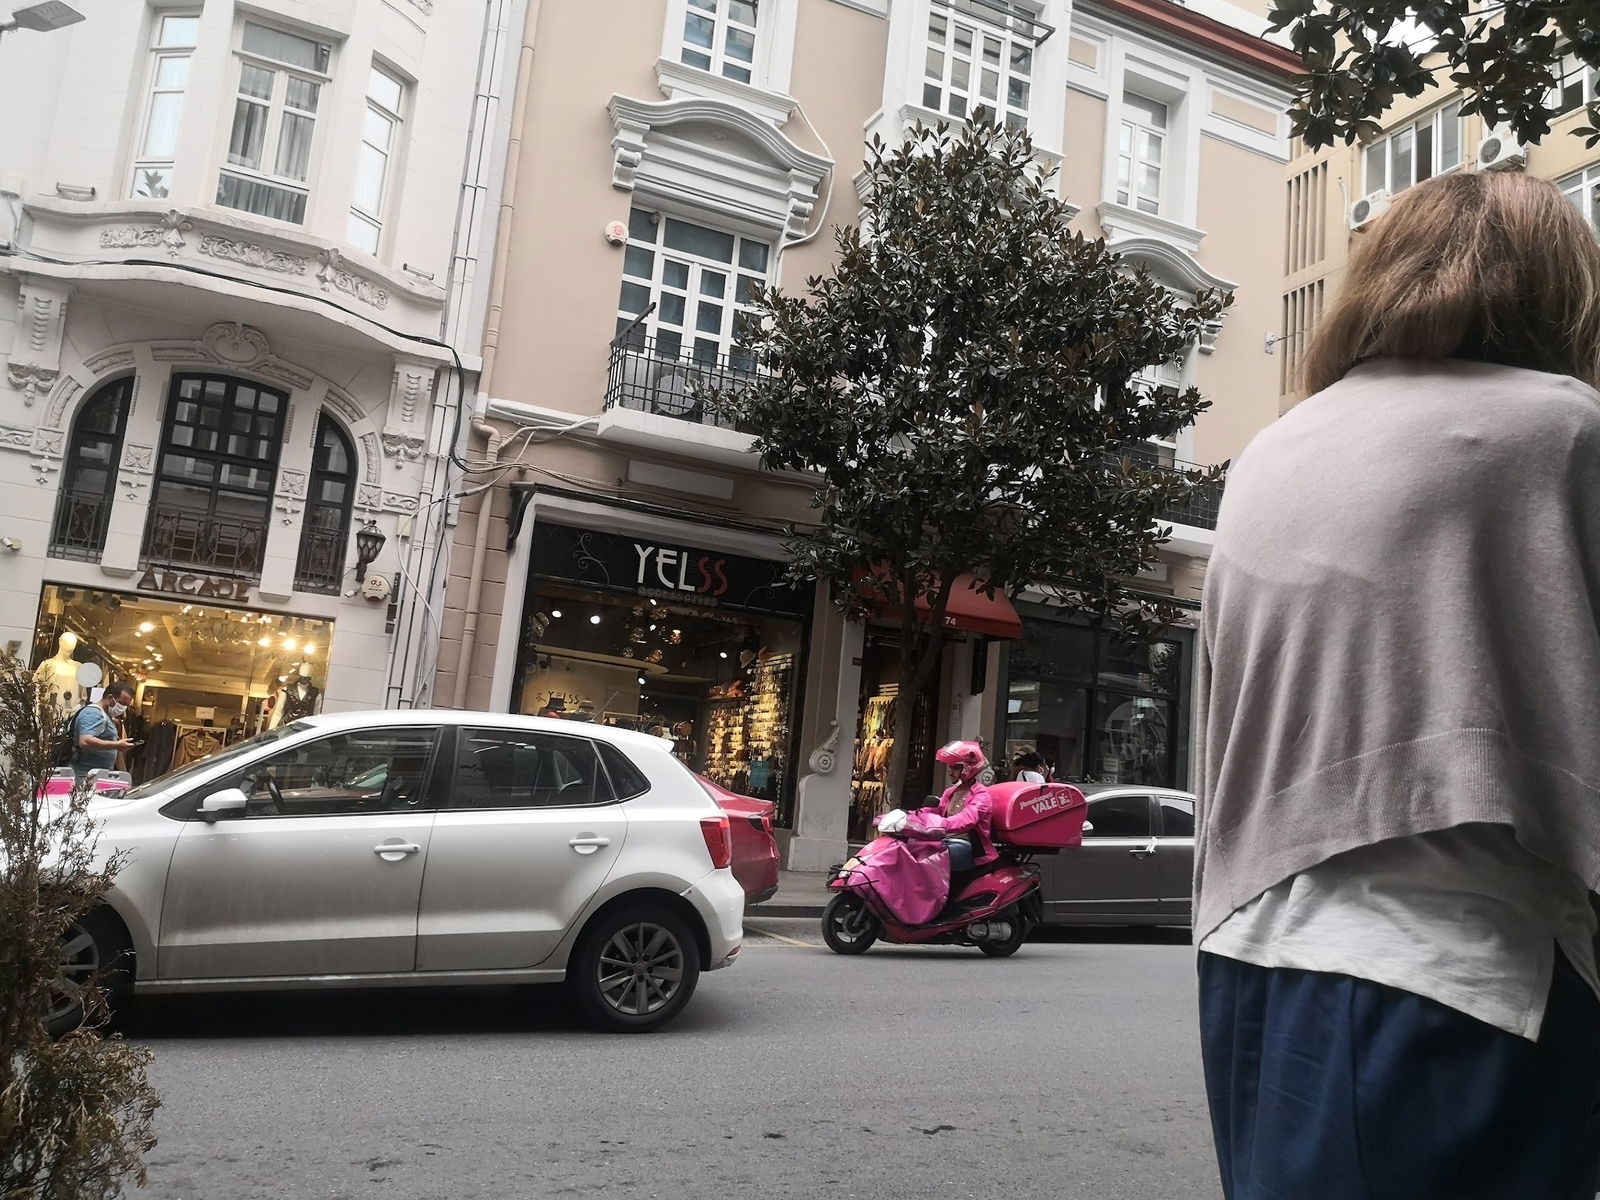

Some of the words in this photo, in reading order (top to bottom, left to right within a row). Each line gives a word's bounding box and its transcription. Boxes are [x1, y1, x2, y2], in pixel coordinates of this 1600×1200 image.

[137, 563, 251, 603] ARCADE
[633, 543, 728, 596] YELSS
[945, 616, 956, 626] 74
[1031, 797, 1058, 814] VALE
